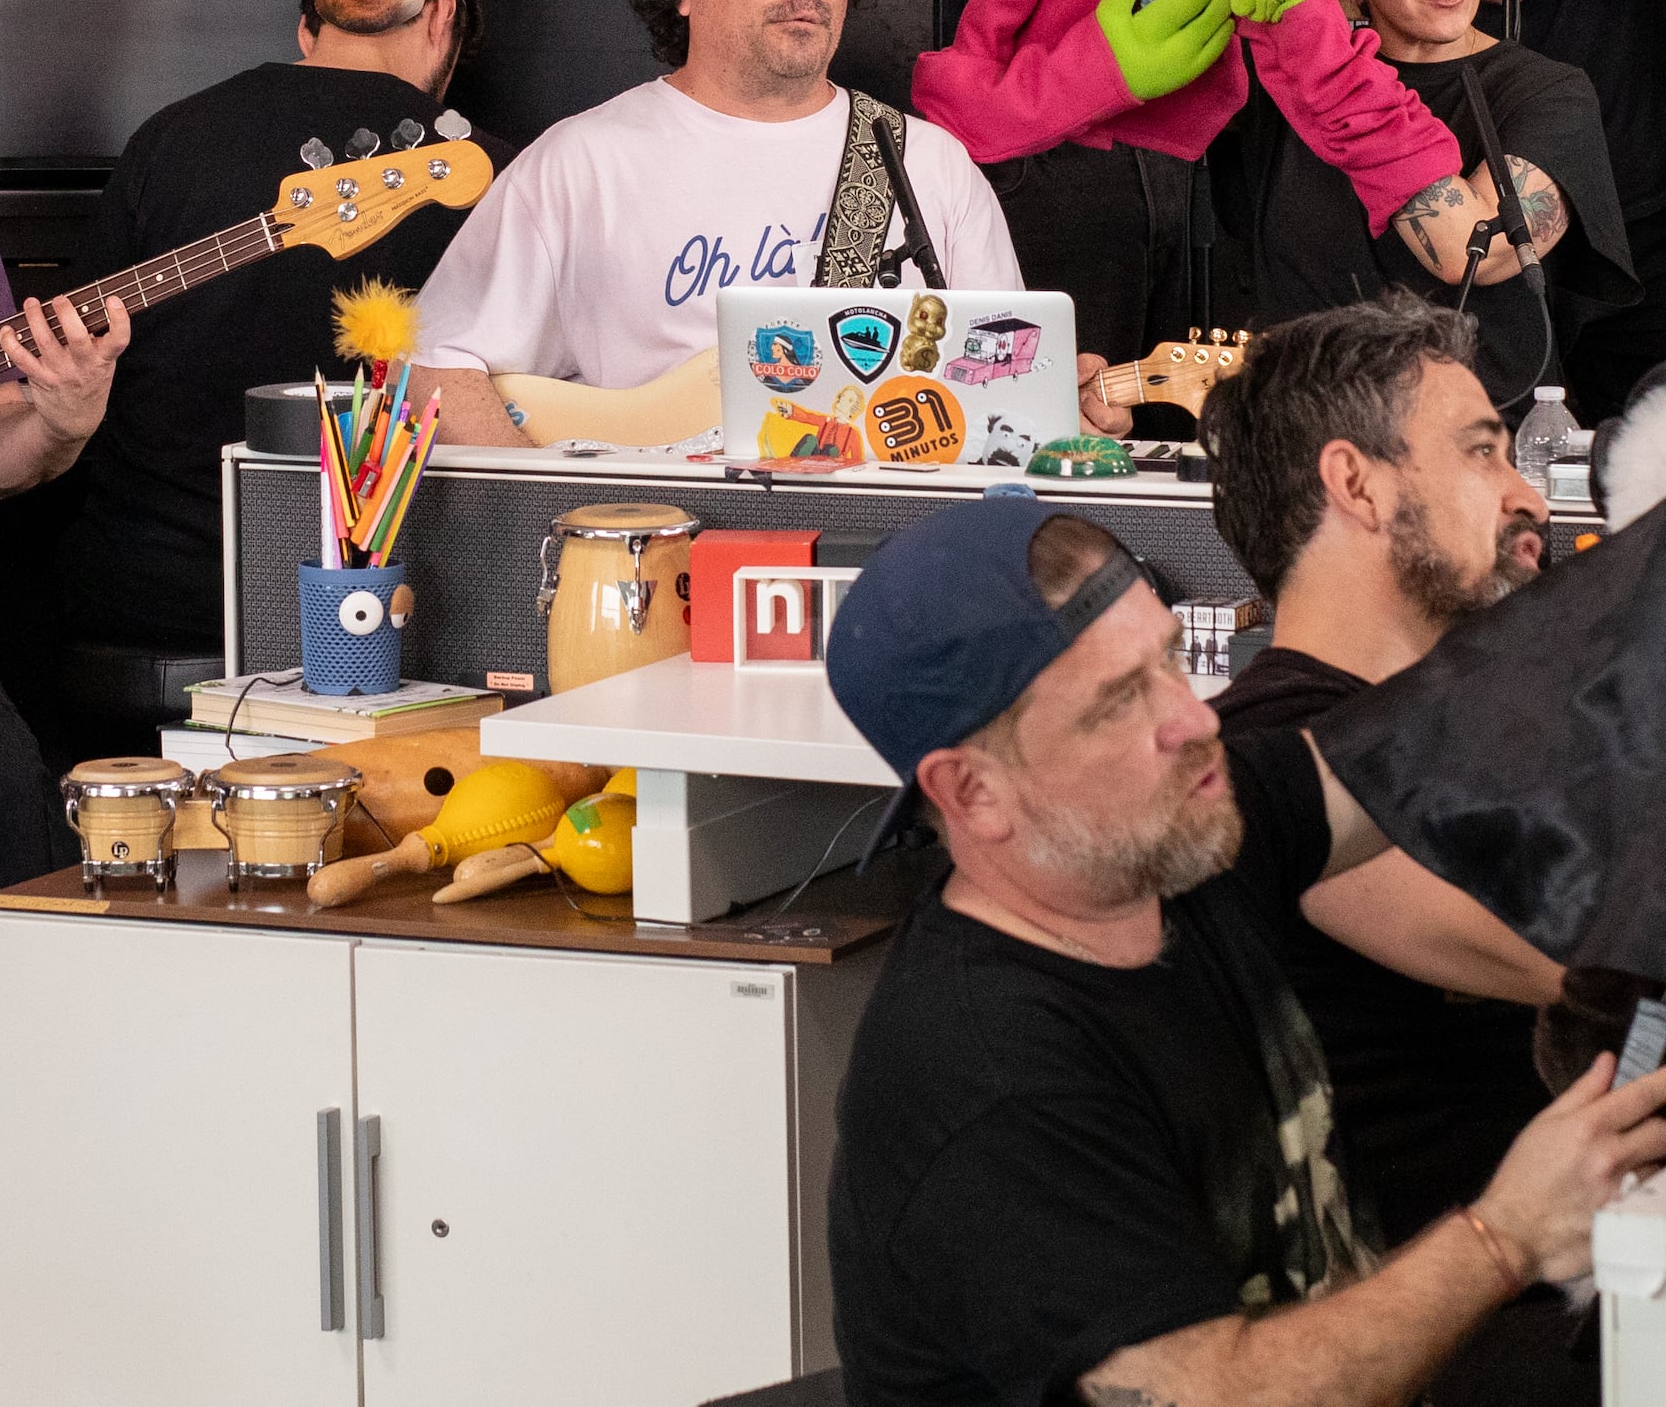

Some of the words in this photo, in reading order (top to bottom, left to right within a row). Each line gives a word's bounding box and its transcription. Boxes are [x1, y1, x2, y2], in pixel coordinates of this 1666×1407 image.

[664, 233, 741, 308] Oh
[843, 307, 888, 320] MOTOLANCHA
[968, 315, 991, 327] DENIS
[991, 310, 1014, 322] DANIS
[755, 365, 784, 377] COLO
[787, 366, 819, 378] COLO
[873, 388, 953, 449] 31
[890, 432, 960, 463] MINUTOS
[754, 578, 807, 635] n
[1186, 609, 1235, 629] BEARTOOTH
